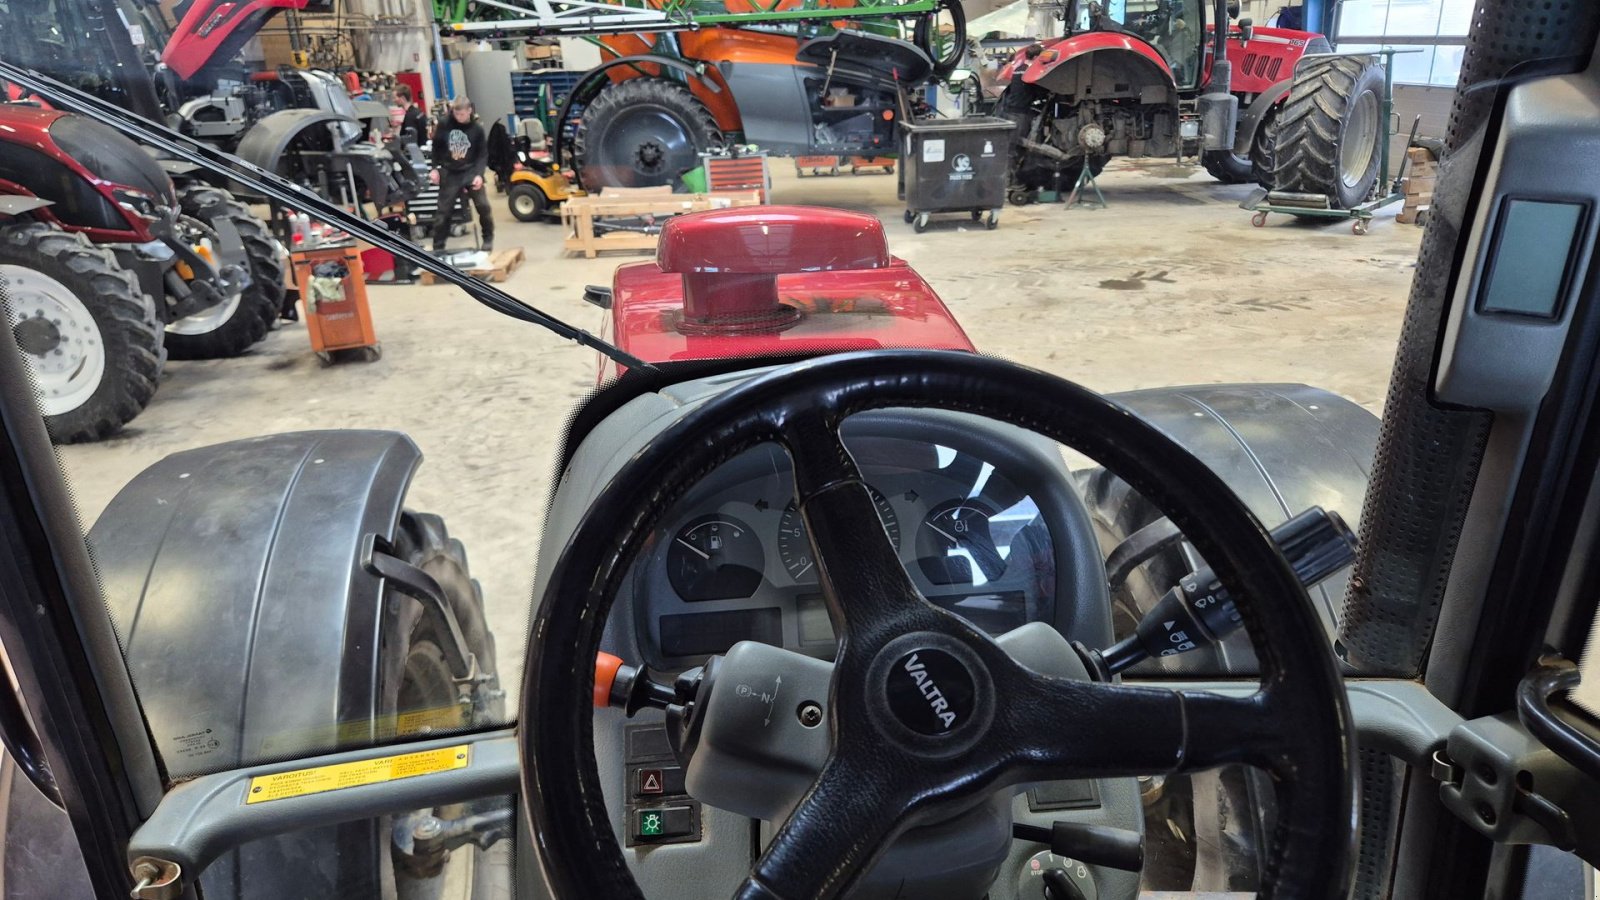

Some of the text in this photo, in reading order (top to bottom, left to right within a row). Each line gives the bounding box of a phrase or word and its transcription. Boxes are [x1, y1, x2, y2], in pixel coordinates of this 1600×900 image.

[794, 528, 801, 537] 5
[800, 556, 807, 566] 0
[904, 653, 957, 728] VALTRA
[761, 692, 770, 703] N
